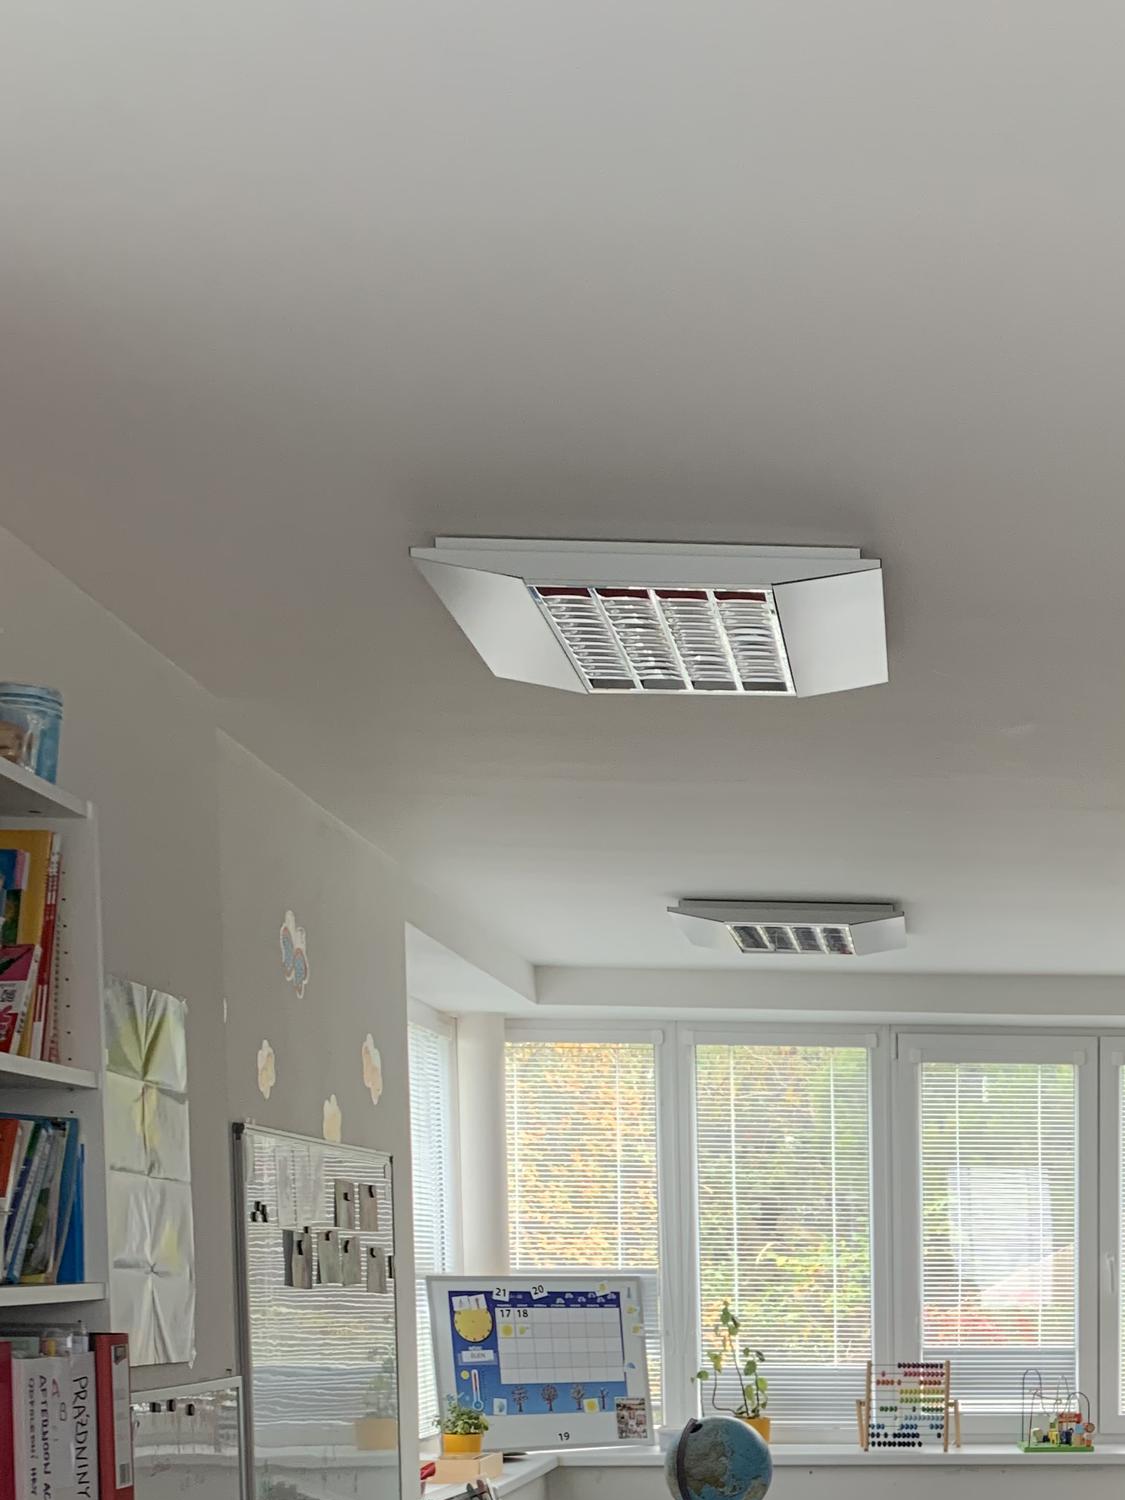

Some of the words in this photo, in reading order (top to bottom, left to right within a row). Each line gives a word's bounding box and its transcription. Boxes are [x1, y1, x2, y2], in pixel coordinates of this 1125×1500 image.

[495, 1287, 507, 1297] 21
[532, 1285, 544, 1295] 20
[500, 1309, 512, 1318] 17
[517, 1309, 529, 1318] 18
[72, 1376, 92, 1499] PRÁZDNINY
[558, 1432, 570, 1441] 19
